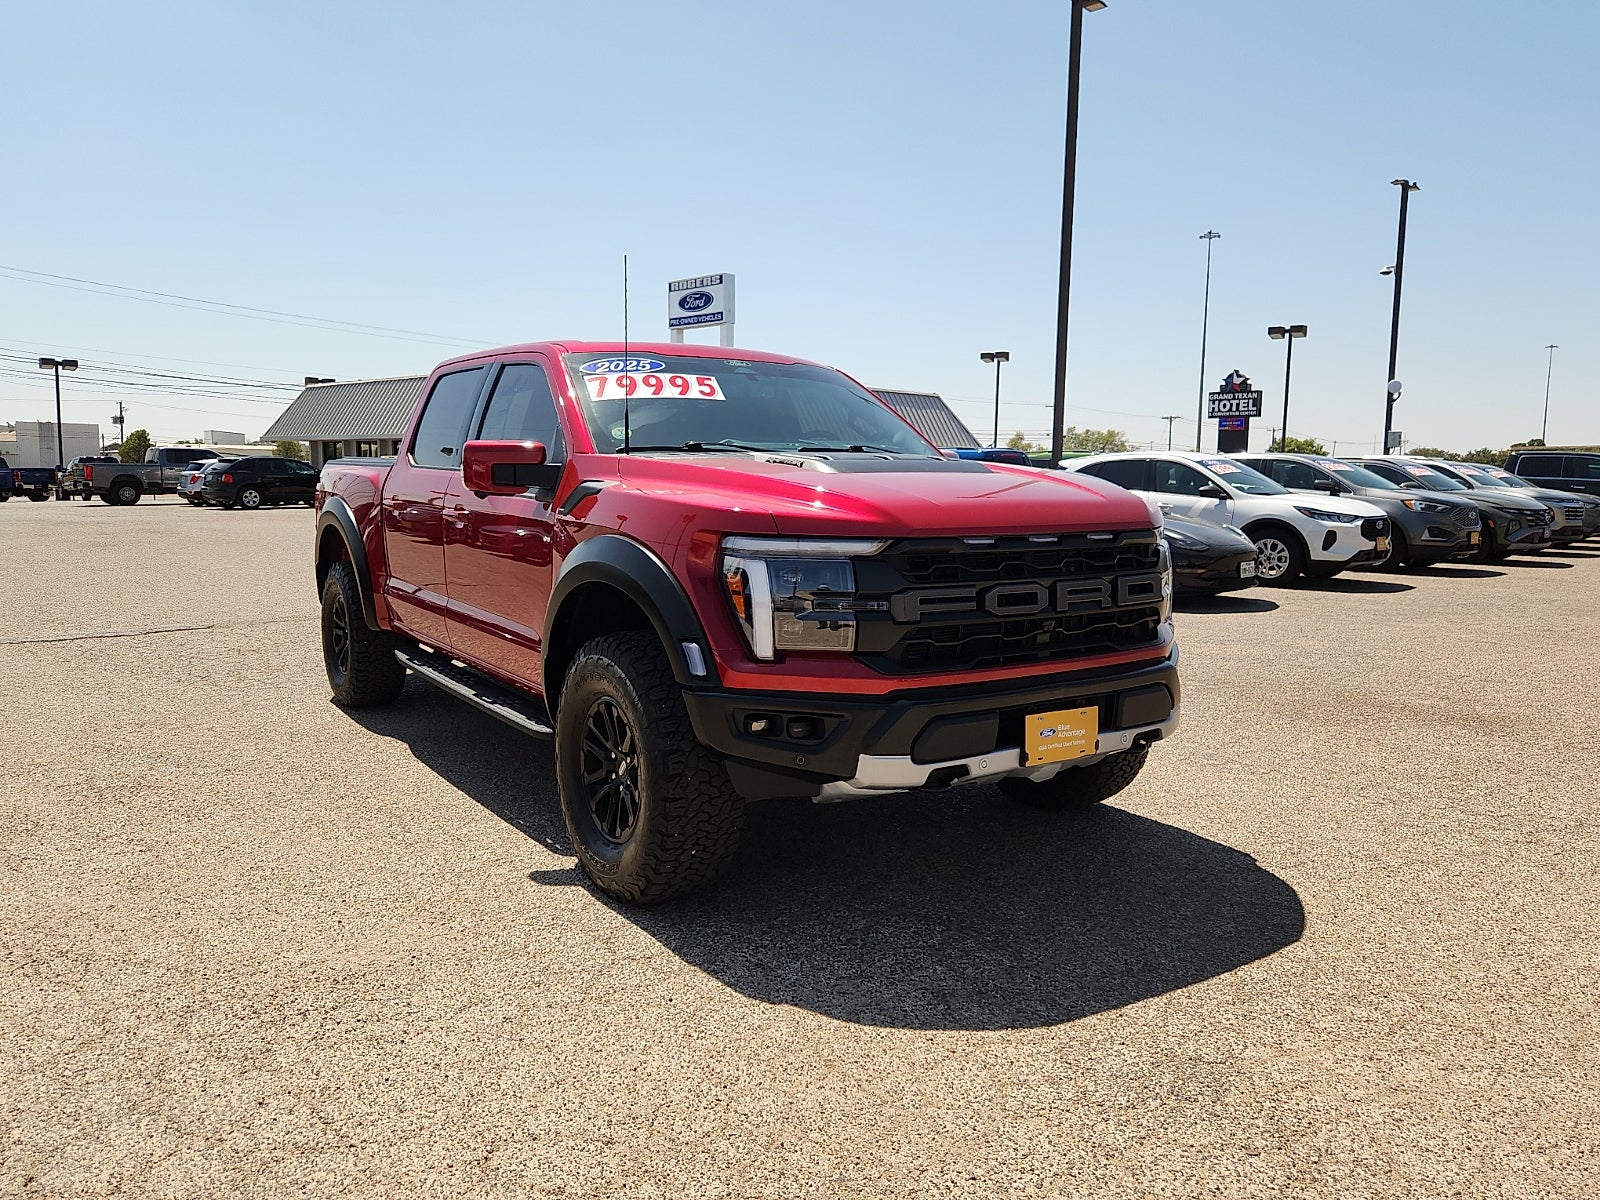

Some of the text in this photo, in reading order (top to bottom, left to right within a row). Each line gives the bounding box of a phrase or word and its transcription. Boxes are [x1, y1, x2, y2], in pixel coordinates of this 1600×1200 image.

[671, 276, 720, 291] ROGERS
[685, 294, 706, 308] Ford
[597, 359, 651, 372] 2025
[587, 375, 718, 398] 79995
[1209, 400, 1257, 412] HOTEL
[890, 573, 1163, 622] FORD
[1058, 729, 1086, 738] Advantage
